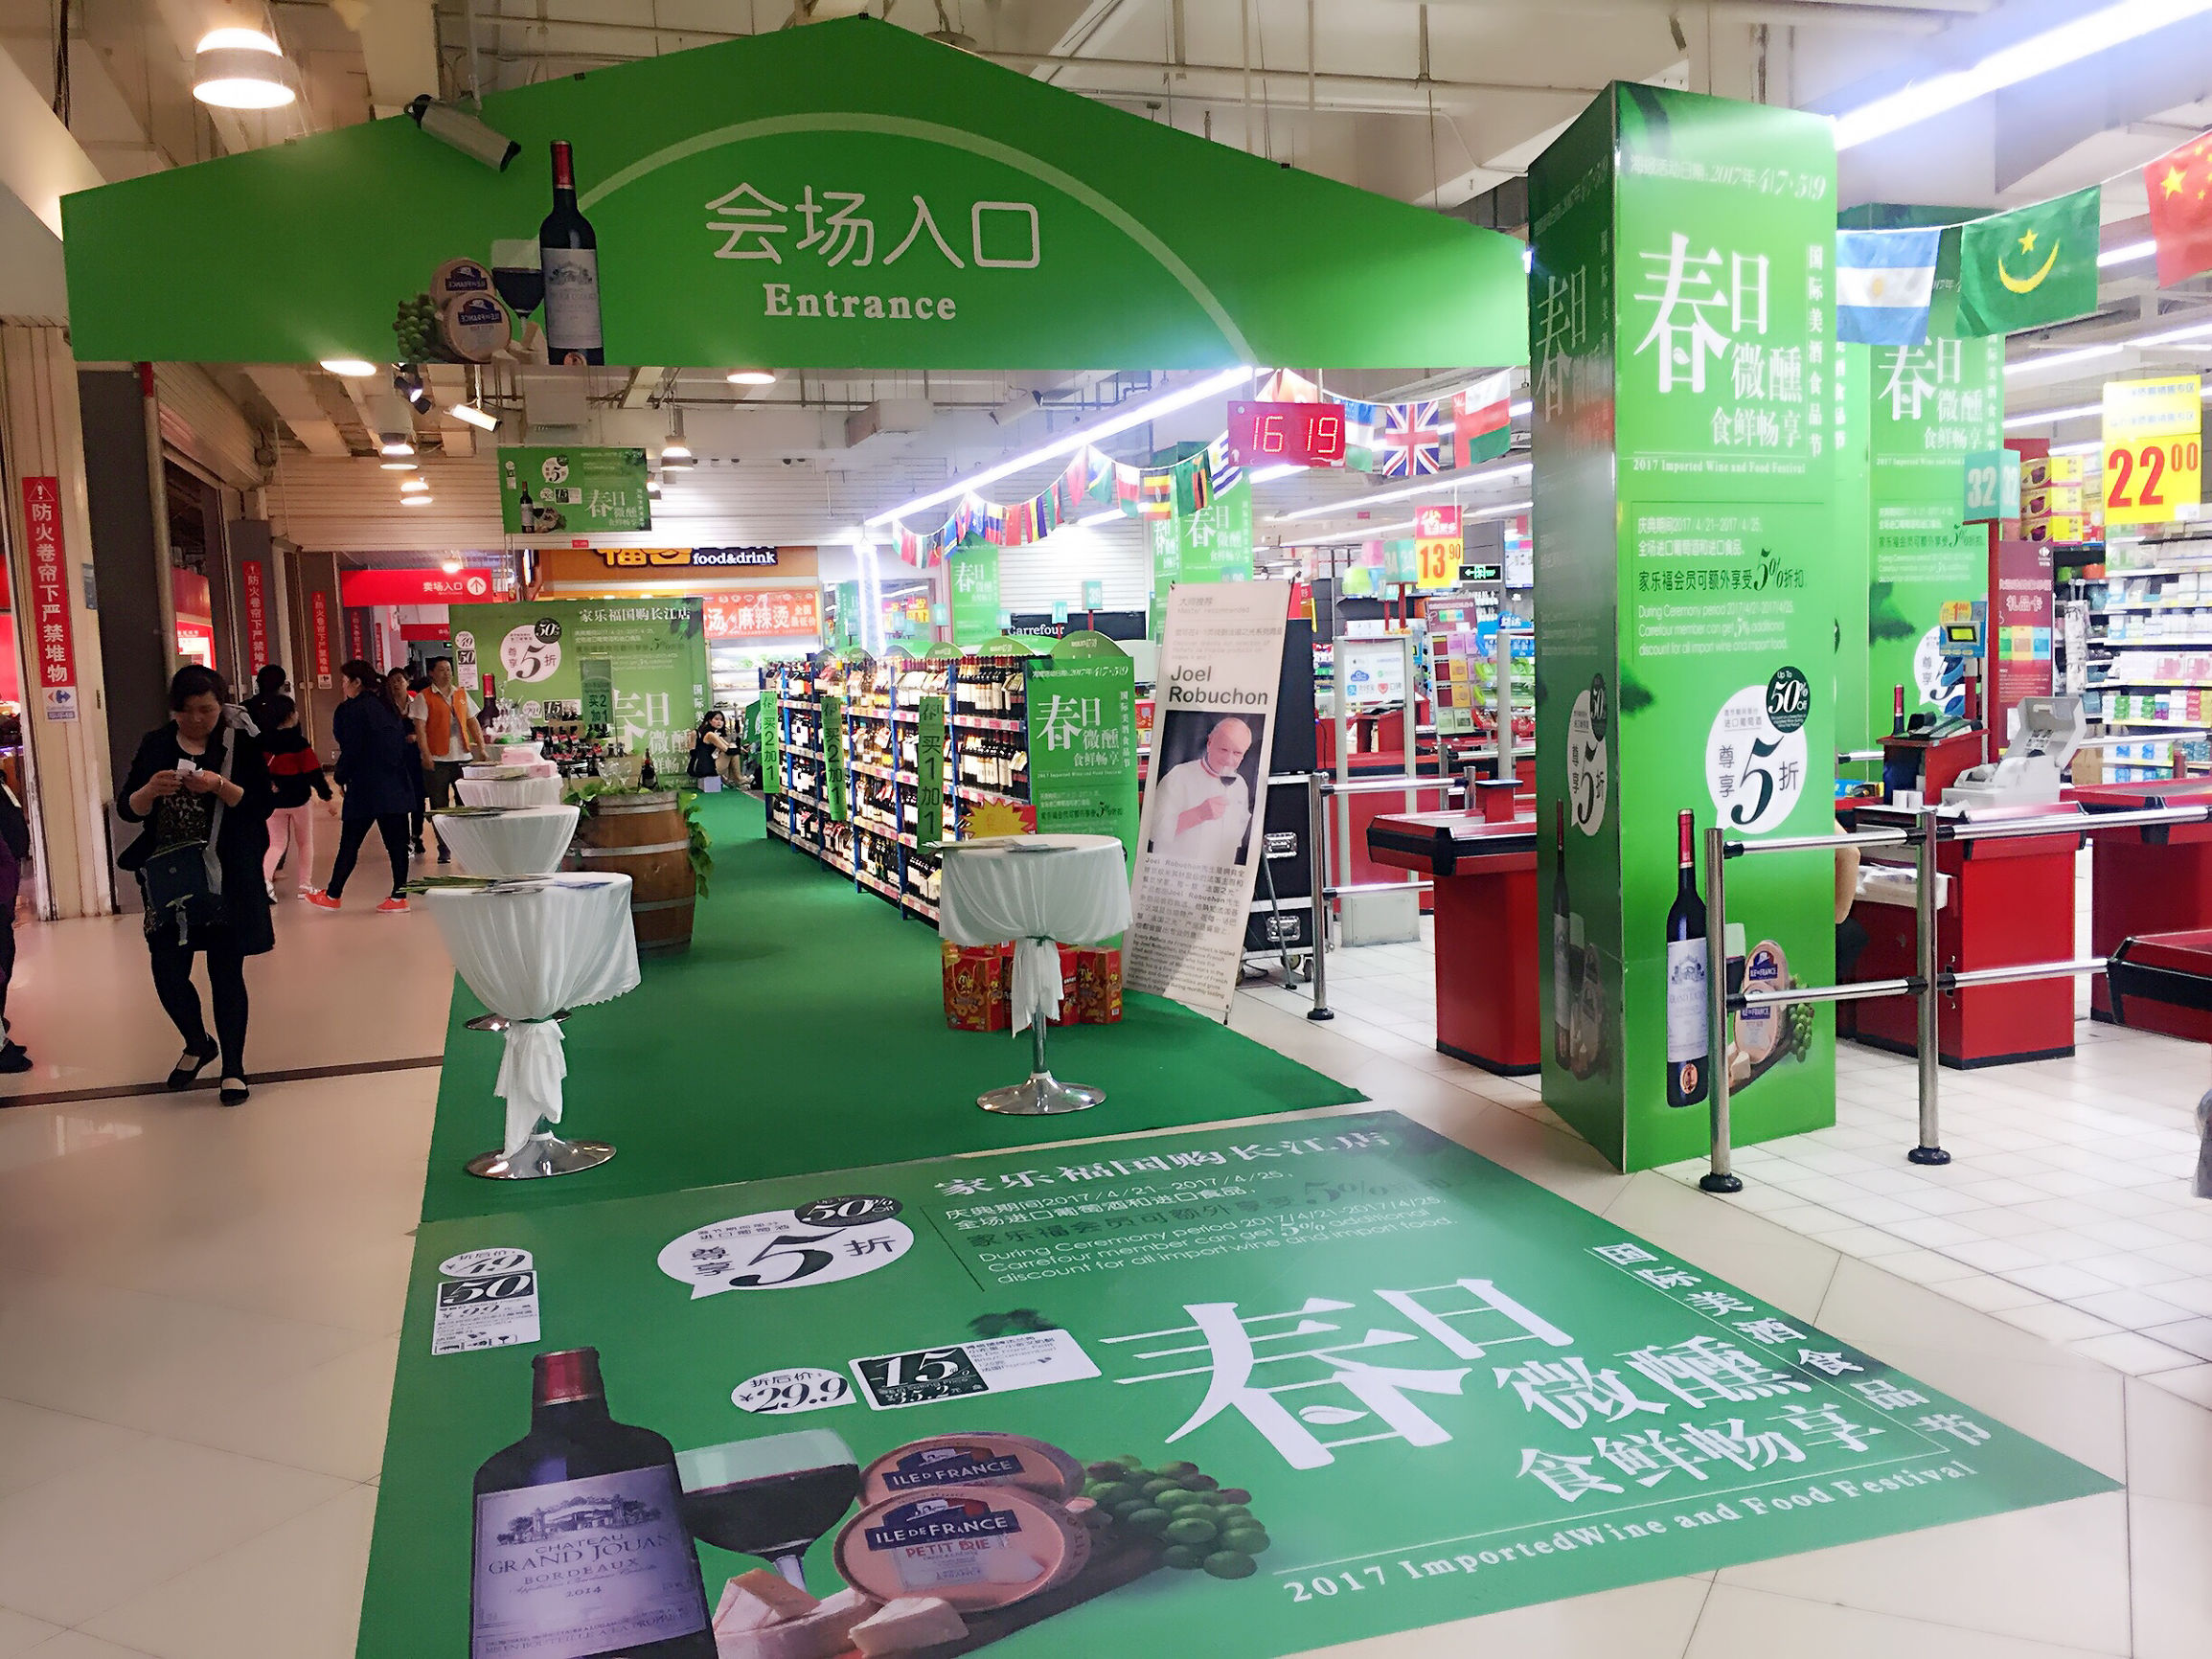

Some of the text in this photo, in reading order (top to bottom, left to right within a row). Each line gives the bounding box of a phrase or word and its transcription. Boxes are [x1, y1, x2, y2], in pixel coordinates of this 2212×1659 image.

[704, 182, 1041, 269] 会场入口
[764, 284, 957, 321] Entrance
[1633, 231, 1769, 394] 春日
[1731, 342, 1802, 402] 微醺
[1807, 244, 1824, 458] 国际美酒食品节
[1253, 415, 1339, 454] 16 19
[1710, 406, 1802, 448] 食鲜畅享
[1633, 460, 1658, 470] 2017
[1661, 460, 1702, 473] Imported
[1968, 466, 1996, 509] 32
[2108, 443, 2199, 509] 22 00
[693, 552, 777, 565] food&drink
[1420, 543, 1461, 579] 13 90
[32, 503, 68, 683] 防火卷帘下严禁堆物
[422, 580, 464, 592] 卖场入口
[579, 606, 692, 623] 家乐福国购长江店
[1008, 624, 1064, 636] Carrefour
[515, 645, 546, 679] 5
[545, 654, 558, 668] 折
[1171, 665, 1212, 682] Joel
[589, 694, 607, 707] 买2
[1169, 686, 1268, 706] Robuchon
[1036, 694, 1101, 752] 春日
[1083, 728, 1120, 750] 微醺
[764, 716, 777, 781] 买2加1
[825, 729, 843, 805] 买2加1
[922, 735, 942, 835] 买1加1
[1719, 744, 1735, 798] 尊享
[1731, 736, 1784, 825] 5
[1779, 761, 1799, 791] 折
[934, 1131, 1390, 1196] 家乐福国购长江店
[729, 1228, 848, 1287] 5
[843, 1236, 897, 1258] 折
[978, 1245, 1052, 1263] During
[1055, 1231, 1167, 1252] Ceremony
[1173, 1221, 1238, 1243] period
[988, 1251, 1092, 1273] Carrefour
[1100, 1237, 1189, 1258] member
[1194, 1233, 1236, 1245] can
[1246, 1227, 1276, 1241] get
[1329, 1210, 1431, 1228] additional
[997, 1262, 1092, 1284] discount
[1096, 1258, 1125, 1271] for
[1131, 1252, 1155, 1265] all
[1157, 1244, 1230, 1264] import
[1230, 1237, 1282, 1253] wine
[1286, 1232, 1330, 1246] and
[1333, 1224, 1399, 1241] import
[1591, 1242, 1992, 1446] 国际美酒食品节
[1098, 1278, 1575, 1471] 春日
[1492, 1335, 1813, 1430] 微醺
[936, 1460, 1013, 1480] FRANCE
[1516, 1403, 1887, 1503] 食鲜畅享
[535, 1534, 625, 1555] CHATEAU
[876, 1529, 907, 1544] ILE
[929, 1516, 1009, 1537] FRANCE
[906, 1537, 992, 1559] PETIT BRIE
[1283, 1562, 1391, 1603] 2017
[1674, 1502, 1744, 1532] and
[1742, 1484, 1837, 1516] Food
[1839, 1458, 1981, 1500] Festival
[489, 1548, 583, 1576] GRAND
[523, 1557, 641, 1586] BORDEAUX
[565, 1585, 604, 1599] 2014
